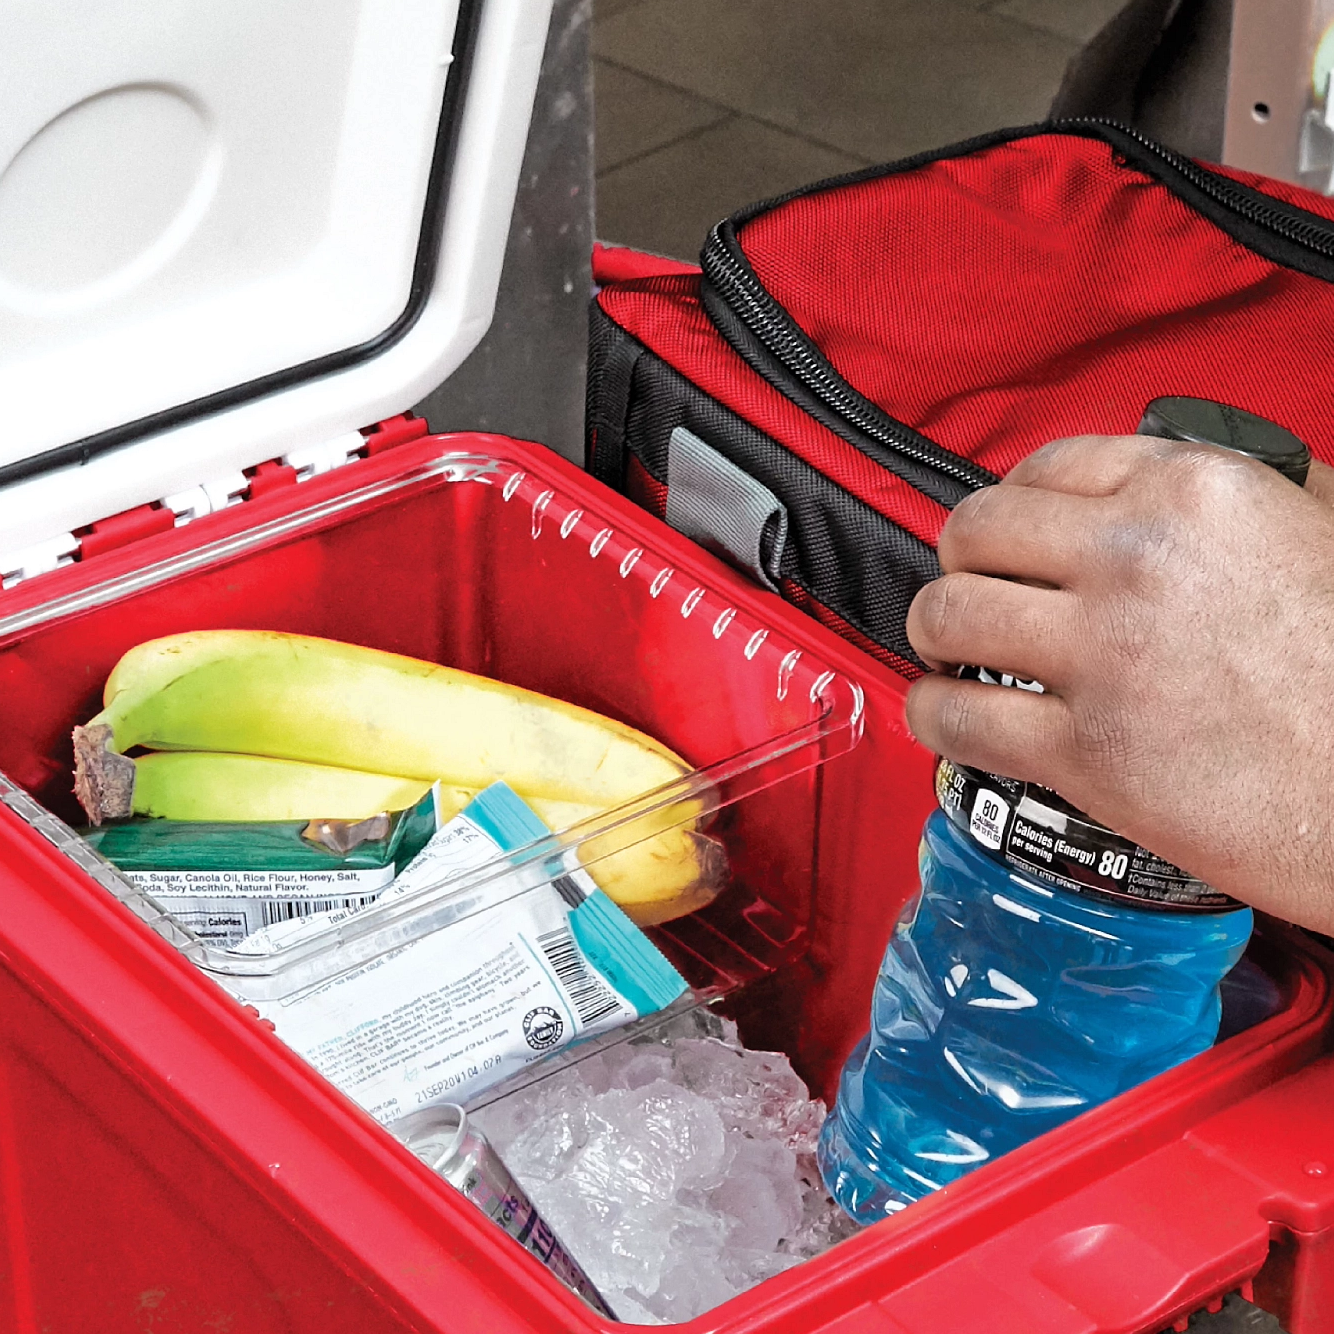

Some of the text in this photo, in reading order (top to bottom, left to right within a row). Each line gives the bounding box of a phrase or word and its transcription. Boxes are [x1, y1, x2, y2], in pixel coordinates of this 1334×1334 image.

[982, 799, 999, 821] 80
[1012, 836, 1053, 863] per serving
[1016, 821, 1128, 879] Calories (Energy) 80
[150, 873, 183, 884] Sugar,
[185, 873, 220, 882] Canola
[223, 873, 241, 883] Oil,
[243, 873, 266, 882] Rice
[268, 873, 297, 883] Flour,
[300, 873, 335, 883] Honey,
[337, 872, 360, 882] Salt,
[1038, 870, 1056, 883] AFTER
[167, 884, 186, 893] Soy
[190, 884, 233, 893] Lecithin,
[236, 884, 272, 892] Natural
[208, 917, 241, 926] Calories
[328, 907, 348, 924] Total
